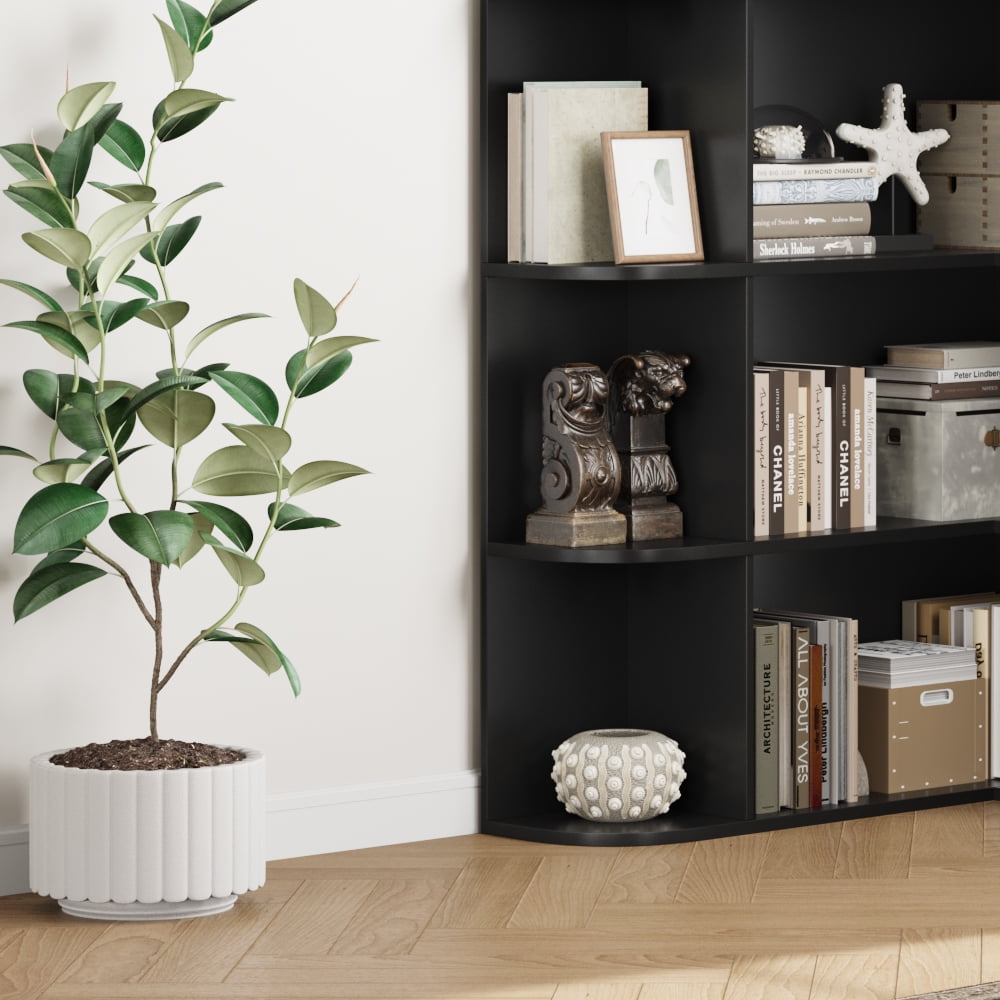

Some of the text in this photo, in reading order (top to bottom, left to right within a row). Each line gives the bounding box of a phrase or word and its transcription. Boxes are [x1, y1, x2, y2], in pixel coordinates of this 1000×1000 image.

[760, 242, 816, 256] Sherlock Holmes
[773, 444, 783, 513] CHANEL
[788, 413, 797, 496] amanda lovelace
[798, 414, 806, 506] Arianna Huffington
[840, 440, 849, 508] CHANEL
[854, 408, 863, 490] amanda lovelace
[763, 664, 771, 754] ARCHITECTURE
[798, 636, 808, 784] ALL ABOUT YVES
